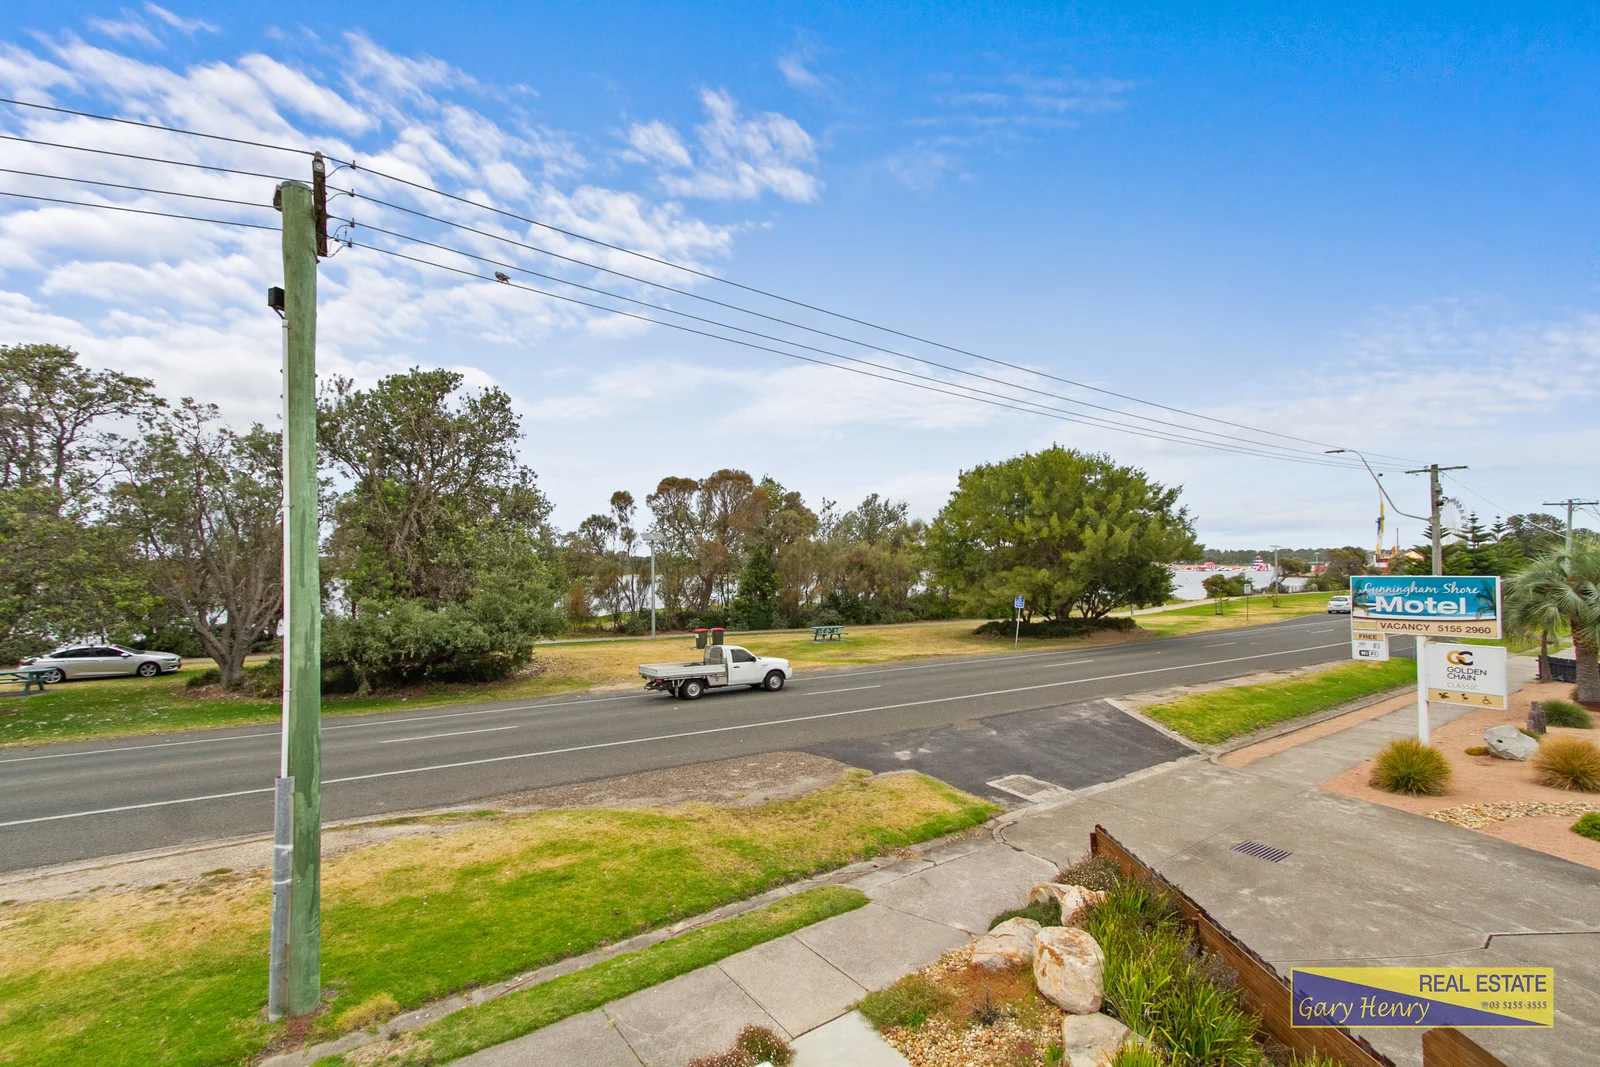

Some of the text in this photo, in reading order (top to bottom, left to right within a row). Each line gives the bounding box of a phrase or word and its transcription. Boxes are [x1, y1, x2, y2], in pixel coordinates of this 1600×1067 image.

[1362, 581, 1480, 597] Cunningham Shore
[1375, 596, 1467, 615] Motel
[1380, 622, 1492, 635] VACANCY 5155 2960
[1447, 666, 1488, 676] GOLDEN
[1447, 673, 1476, 682] CHAIN
[1447, 682, 1480, 691] CLASSIC
